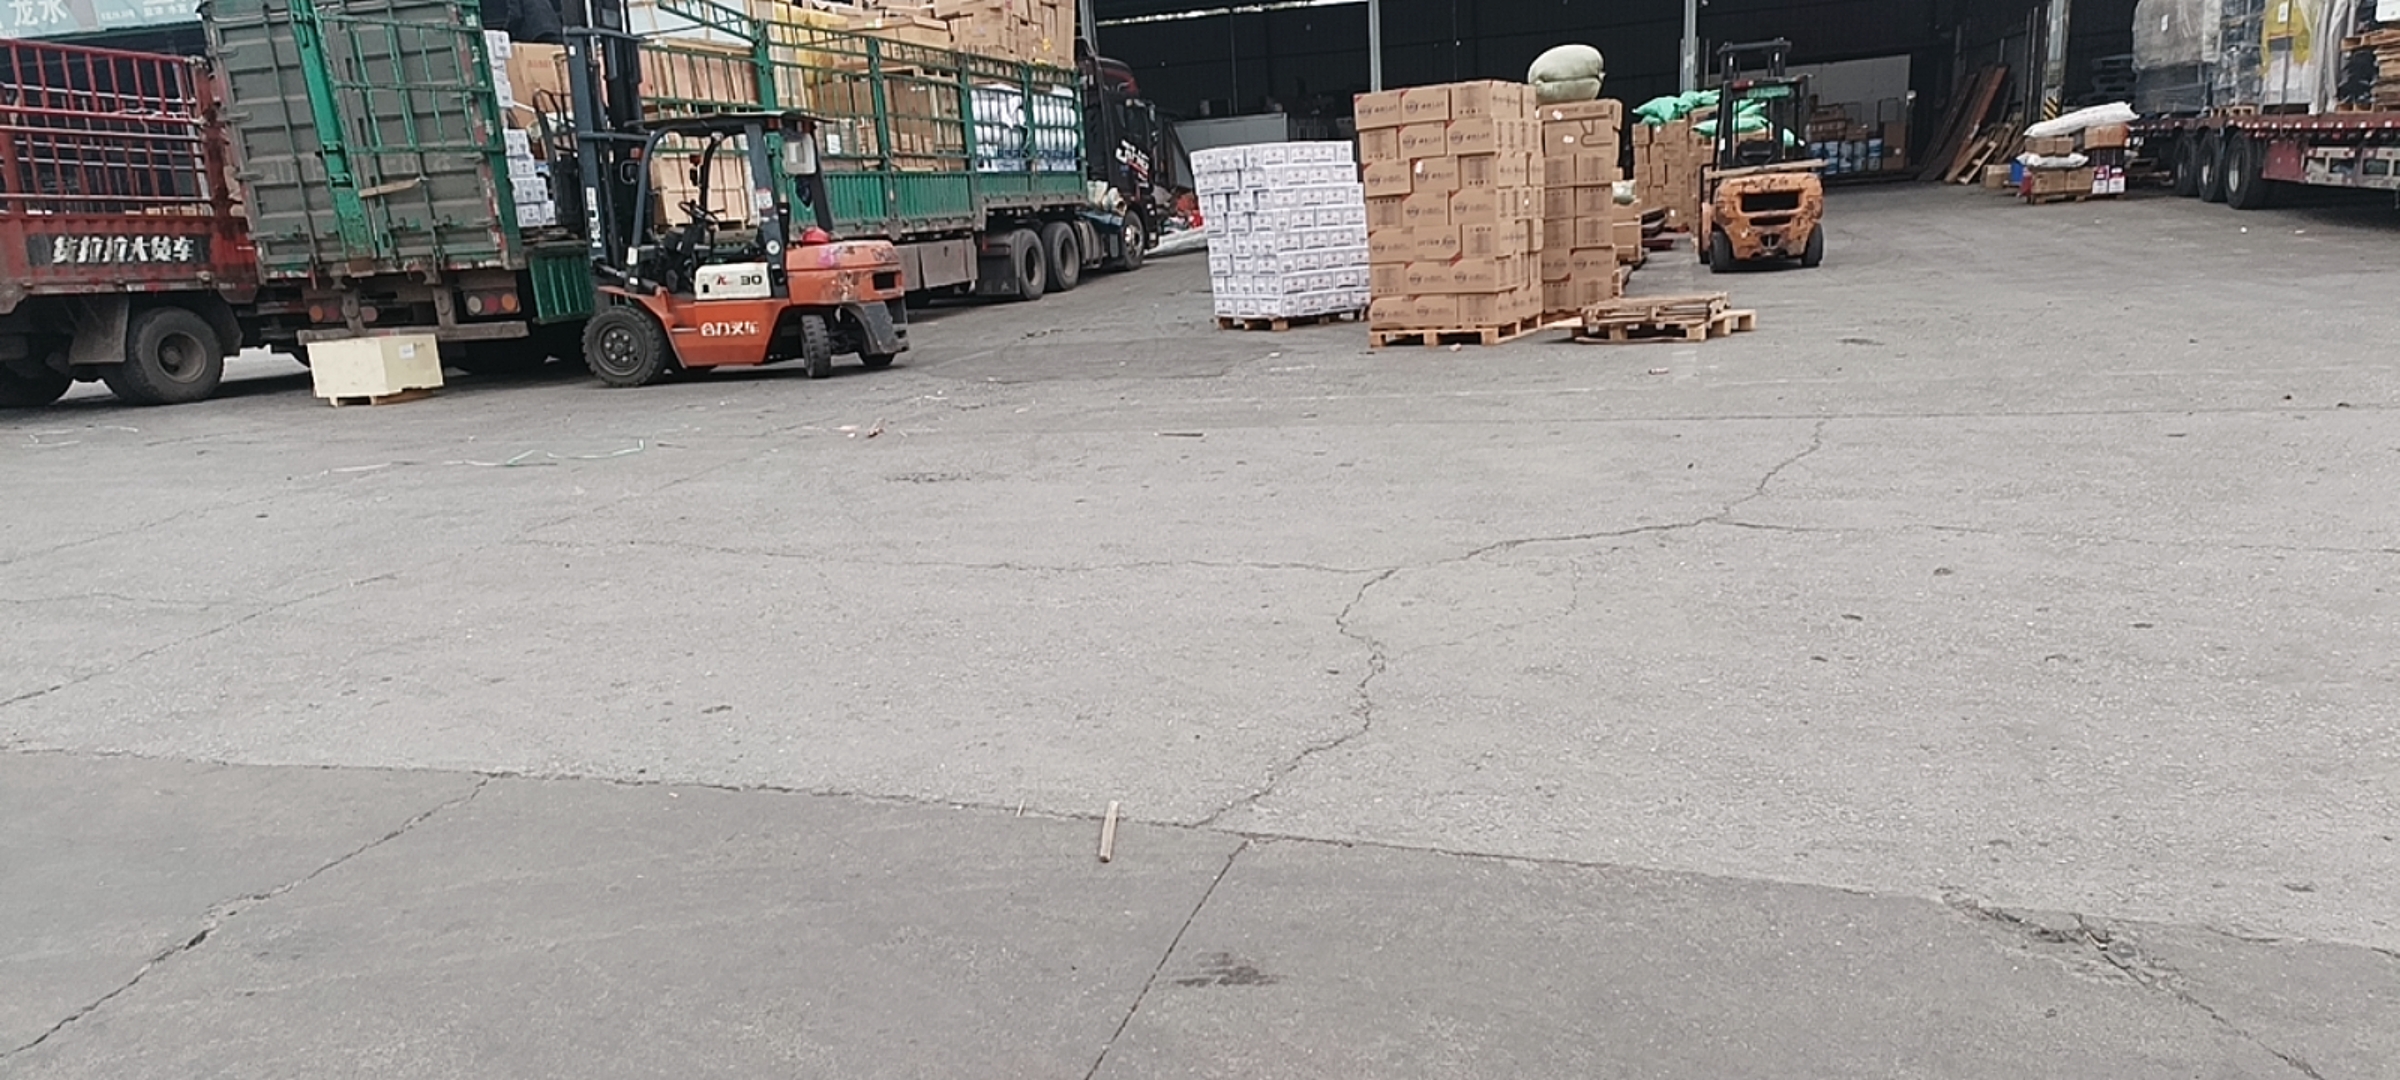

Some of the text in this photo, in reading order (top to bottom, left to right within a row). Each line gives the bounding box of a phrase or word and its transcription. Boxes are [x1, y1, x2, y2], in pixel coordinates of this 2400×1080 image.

[740, 275, 763, 286] 30
[701, 321, 760, 337] 合力叉车
